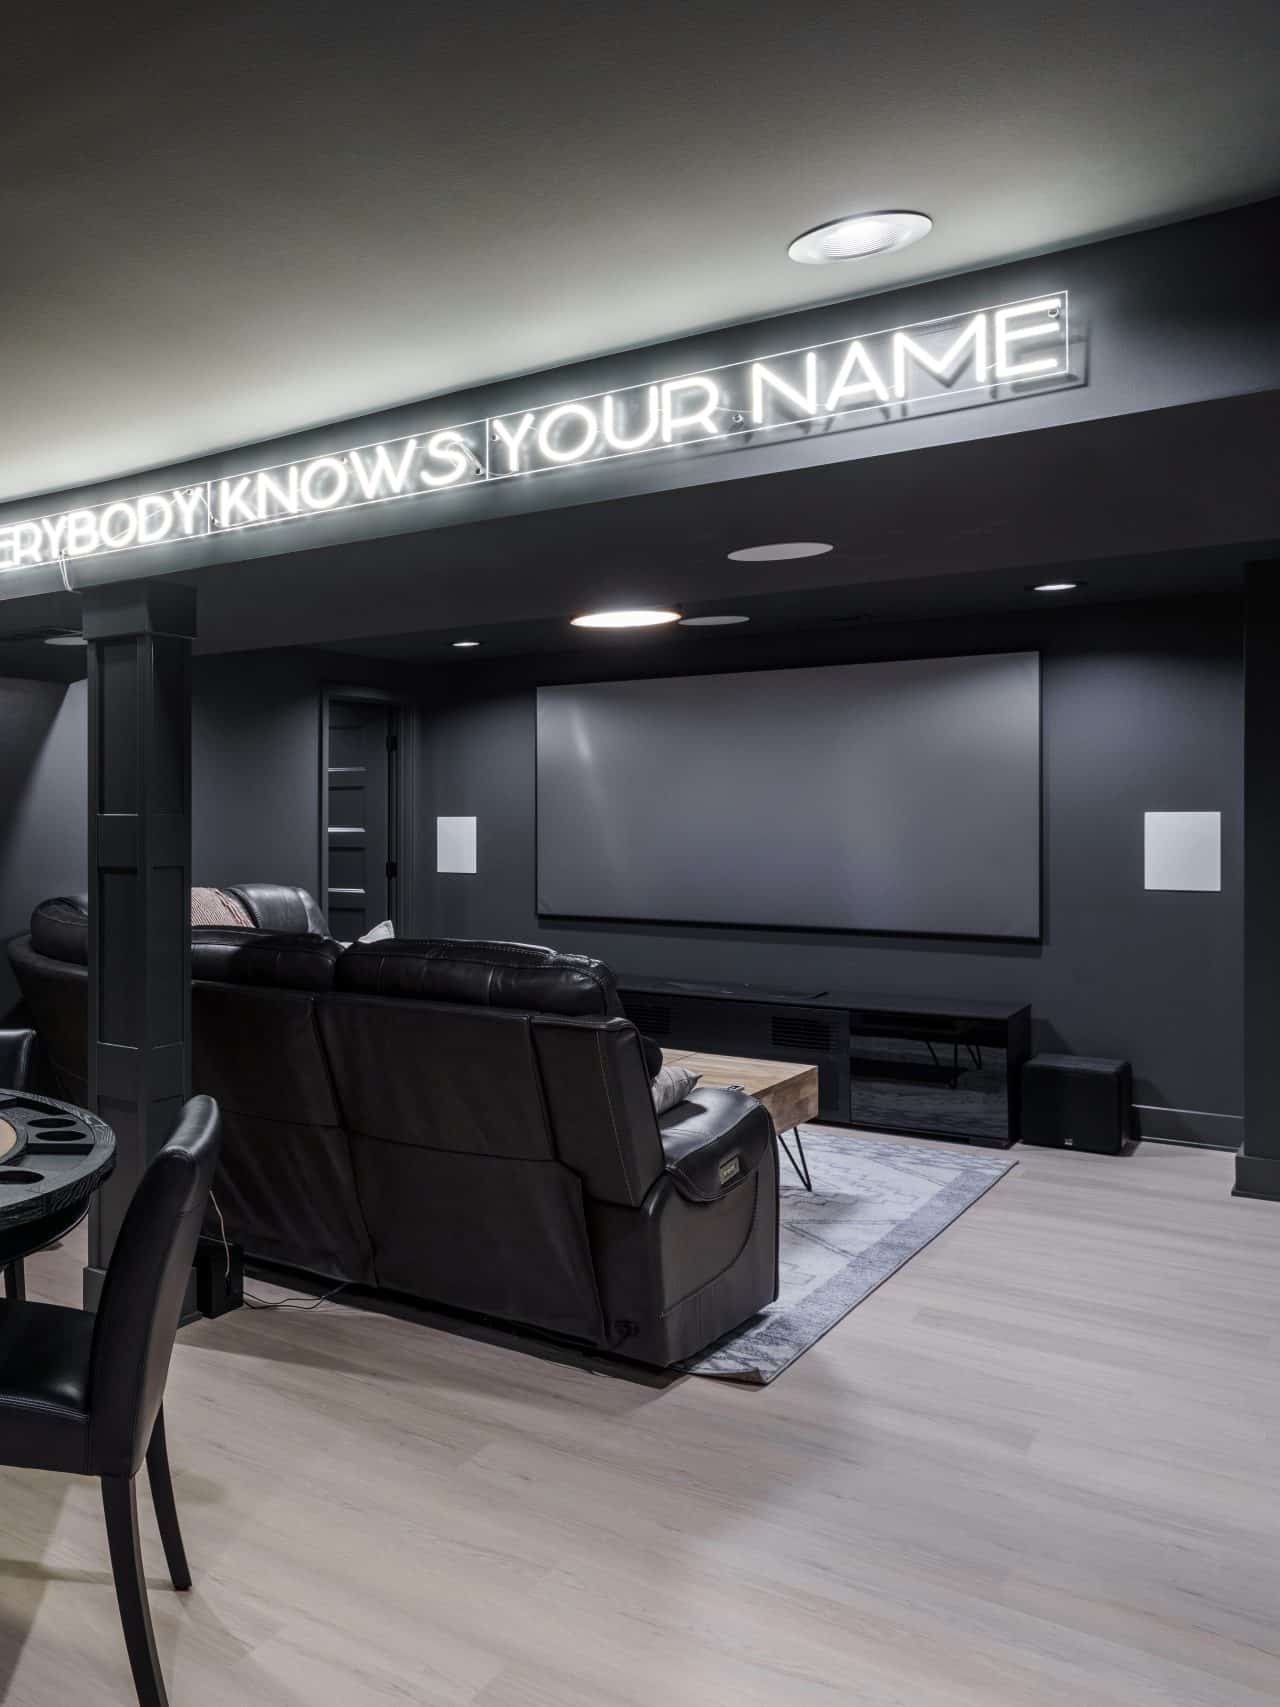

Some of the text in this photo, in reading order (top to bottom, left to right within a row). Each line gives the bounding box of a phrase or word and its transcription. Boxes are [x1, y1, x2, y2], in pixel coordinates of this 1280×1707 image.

[220, 430, 468, 527] KNOWS
[492, 376, 719, 472] YOUR
[752, 298, 1062, 424] NAME
